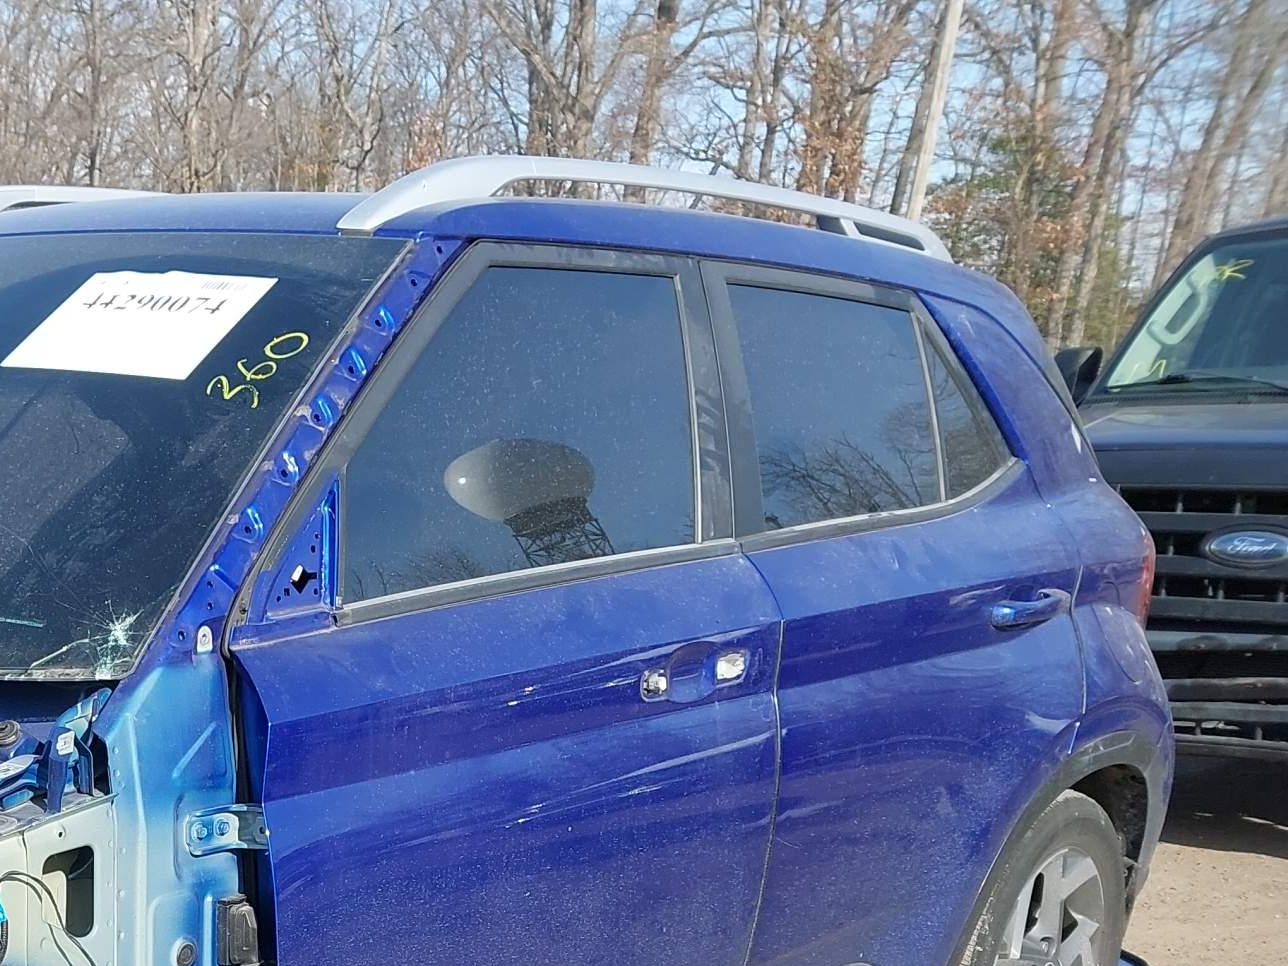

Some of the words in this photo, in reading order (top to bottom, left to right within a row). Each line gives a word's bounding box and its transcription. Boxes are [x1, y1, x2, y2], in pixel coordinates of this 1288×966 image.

[81, 291, 229, 315] 44290074
[205, 330, 310, 409] 360
[1227, 536, 1278, 555] Ford
